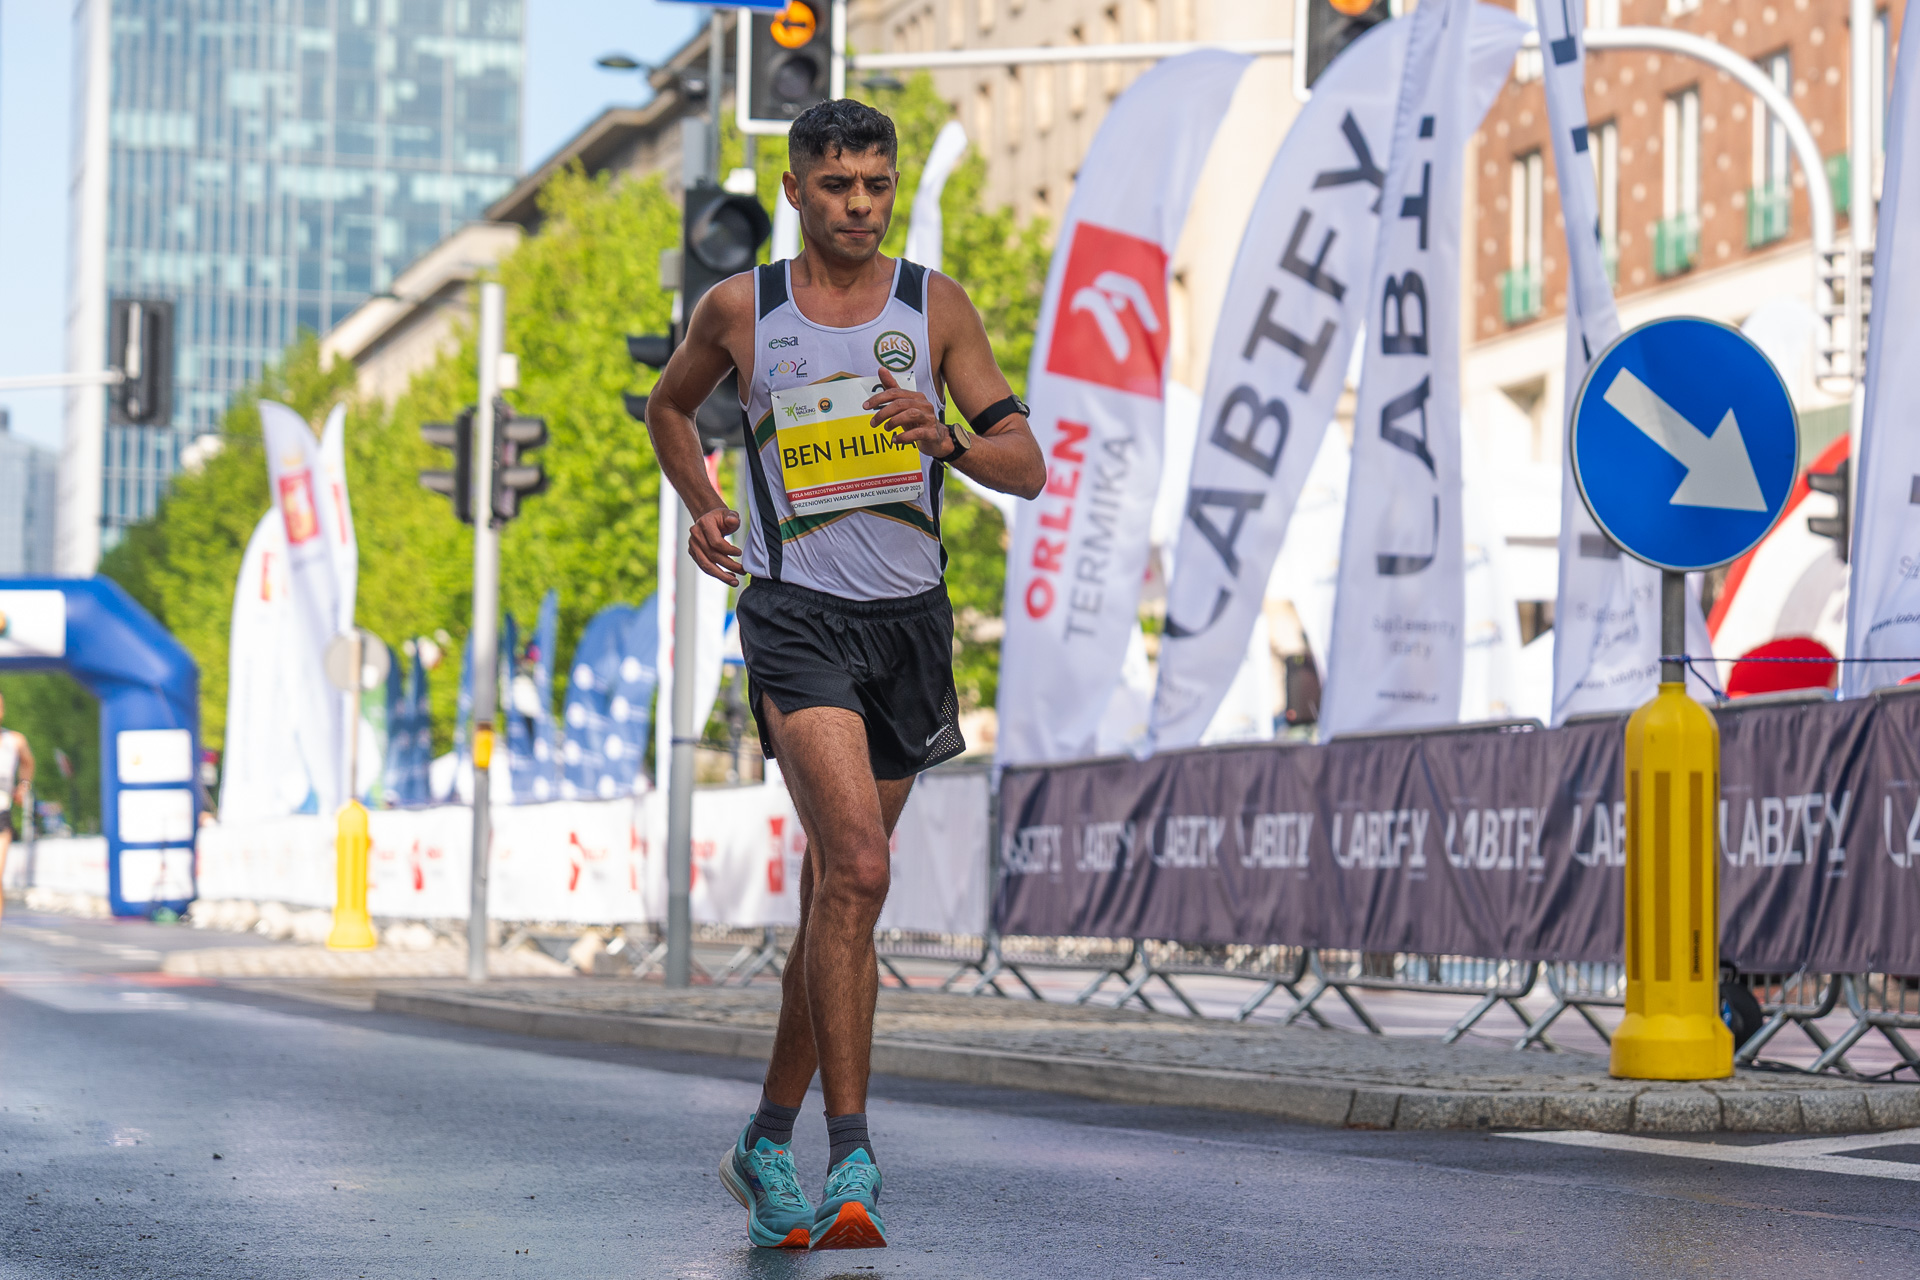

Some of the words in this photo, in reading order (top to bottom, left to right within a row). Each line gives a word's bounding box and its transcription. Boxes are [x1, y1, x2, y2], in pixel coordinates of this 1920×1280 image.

[880, 336, 910, 353] RKS
[783, 440, 832, 469] BEN
[832, 493, 860, 502] WARSAW
[876, 487, 899, 496] WALKING
[860, 480, 881, 488] CHODZIE
[1024, 418, 1091, 621] ORLEN
[1063, 434, 1136, 645] TERMIKA
[1570, 801, 1626, 868] LAB
